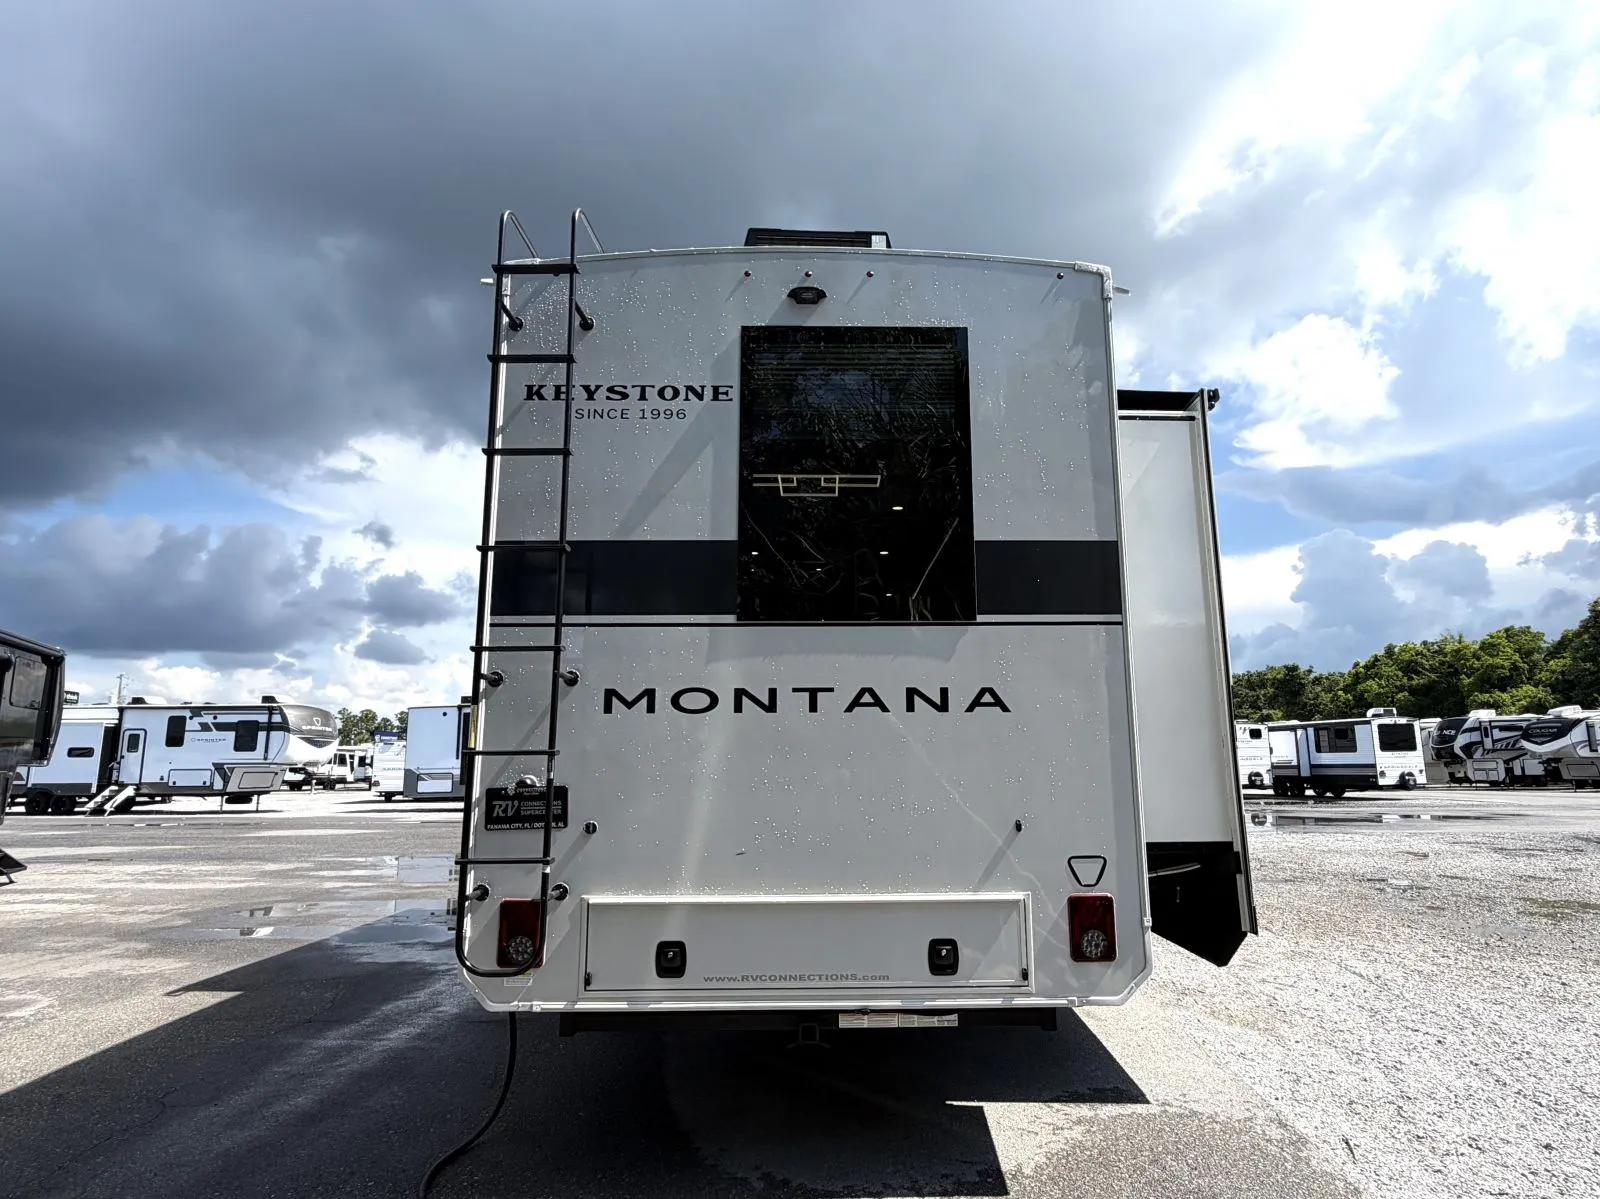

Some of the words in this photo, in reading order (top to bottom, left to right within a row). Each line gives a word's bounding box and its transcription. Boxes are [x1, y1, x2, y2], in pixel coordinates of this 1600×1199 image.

[523, 384, 734, 401] KEYSTONE
[574, 408, 630, 420] SINCE
[639, 408, 687, 420] 1996
[602, 686, 1012, 714] MONTANA
[492, 800, 519, 817] RV
[703, 973, 890, 983] www.RVCONNECTIONS.com
